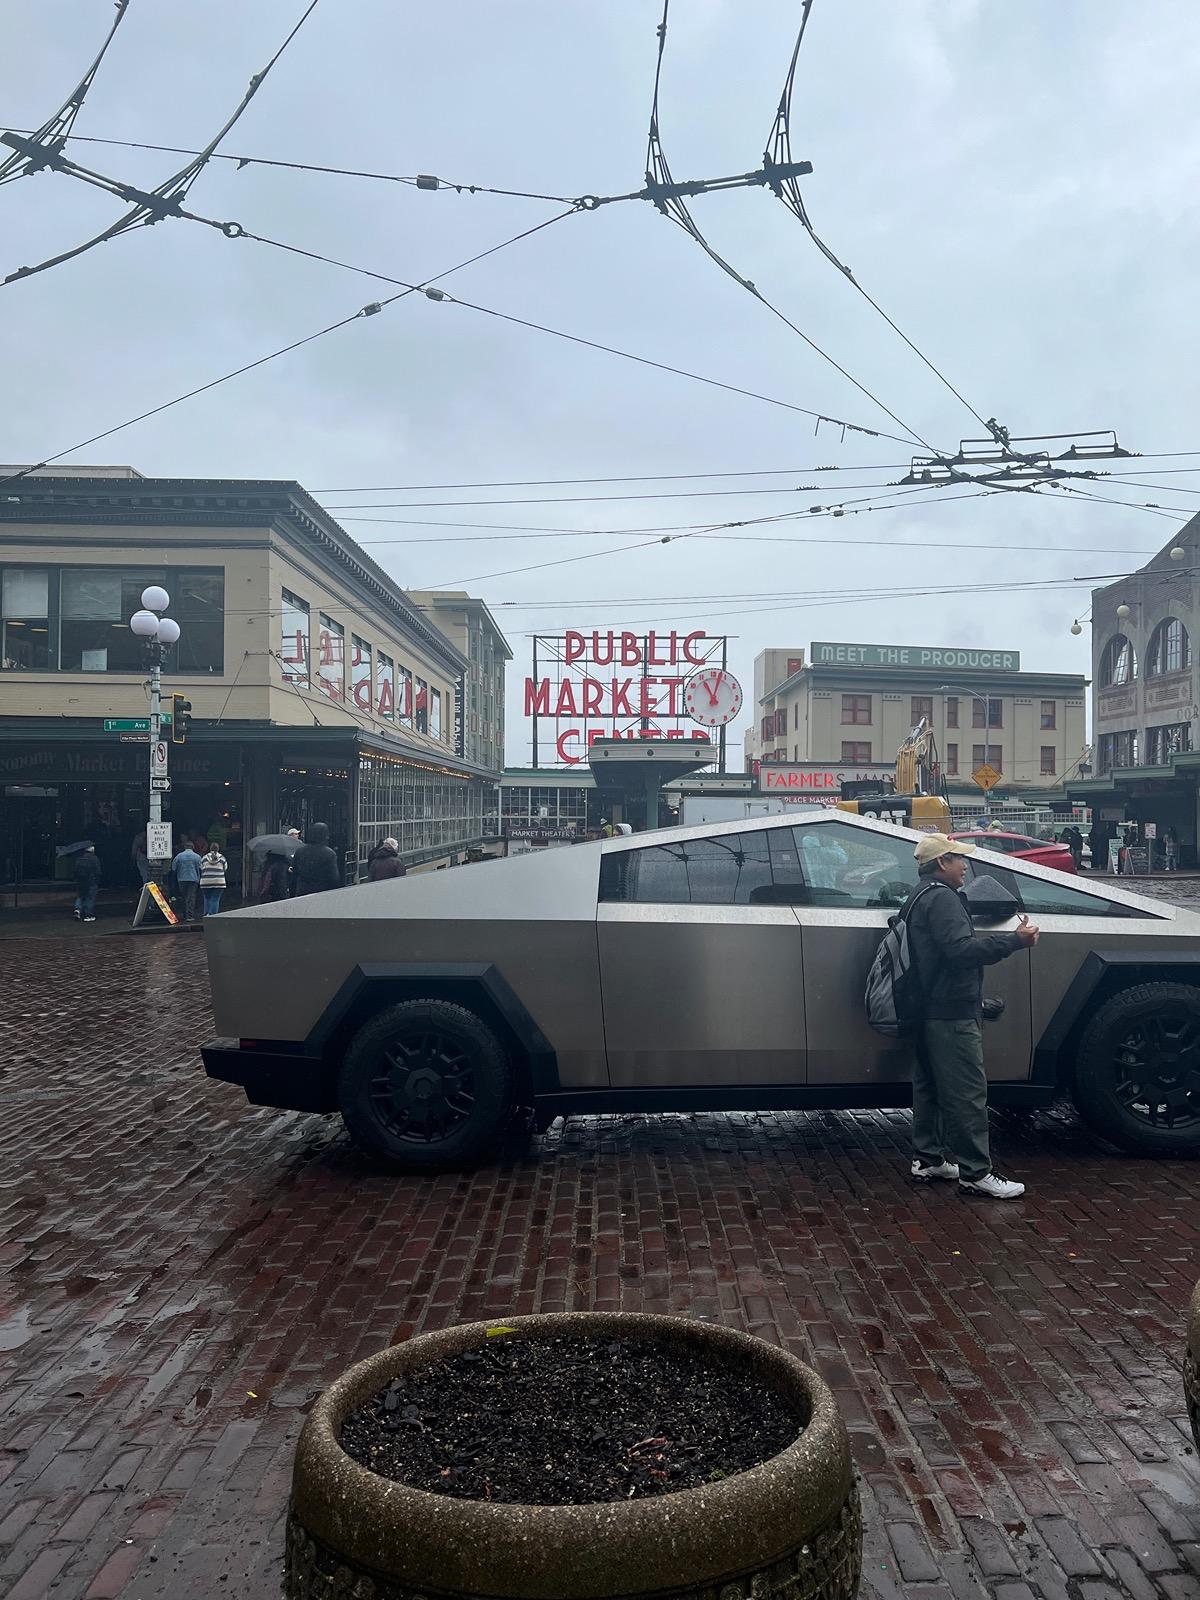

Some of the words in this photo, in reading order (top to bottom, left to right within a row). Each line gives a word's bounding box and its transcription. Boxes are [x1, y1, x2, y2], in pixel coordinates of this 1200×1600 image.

[565, 630, 707, 667] PUBLIC
[821, 645, 867, 662] MEET
[877, 648, 909, 664] THE
[921, 650, 1013, 668] PRODUCER
[524, 678, 685, 718] MARKET
[64, 752, 126, 772] Market
[766, 772, 846, 788] FARMERS
[784, 796, 807, 804] PLACE
[809, 796, 839, 804] MARKET
